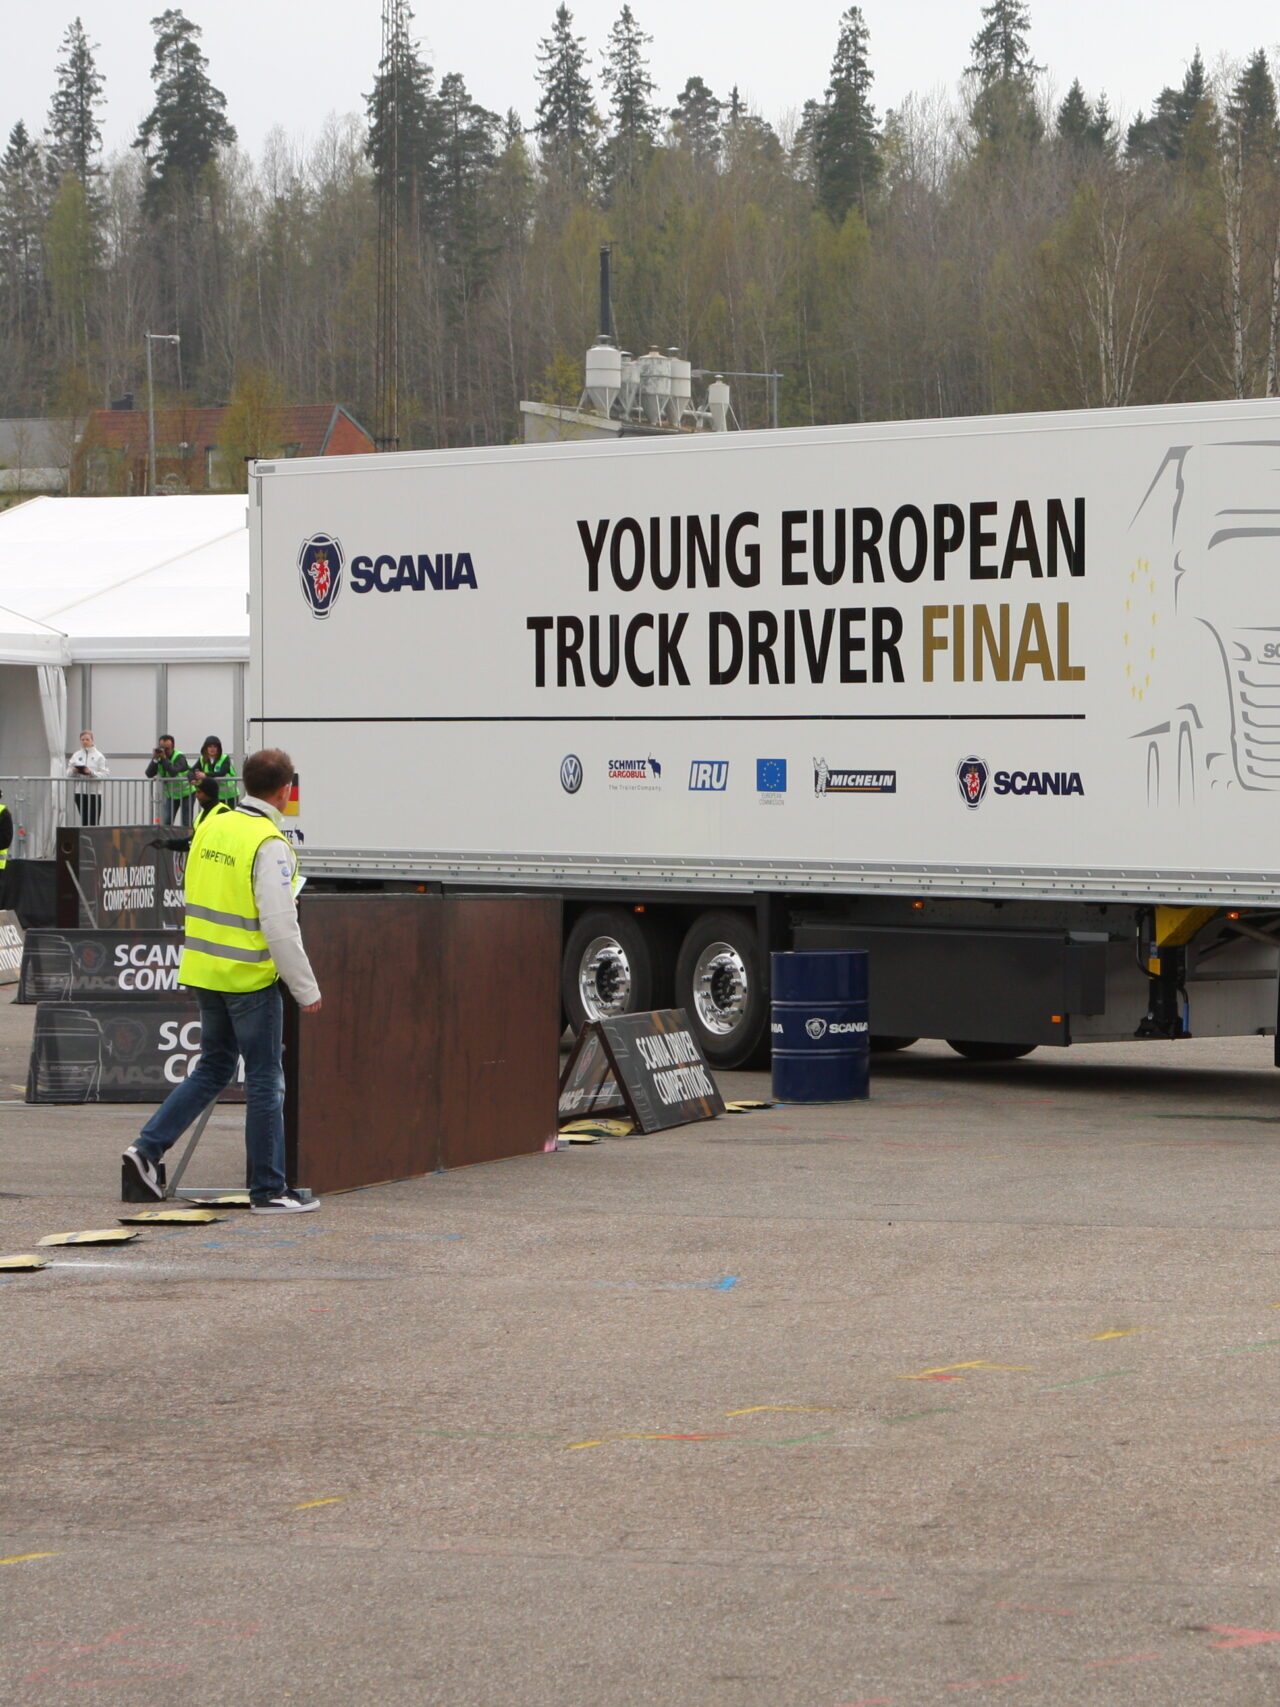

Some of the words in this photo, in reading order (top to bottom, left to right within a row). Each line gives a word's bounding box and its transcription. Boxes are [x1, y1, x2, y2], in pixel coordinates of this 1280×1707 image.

[577, 510, 761, 593] YOUNG
[781, 497, 1086, 586] EUROPEAN
[349, 552, 479, 594] SCANIA
[526, 612, 692, 689] TRUCK
[708, 606, 906, 687] DRIVER
[922, 601, 1086, 683] FINAL
[608, 760, 647, 770] SCHMITZ
[608, 770, 647, 779] CARGOBULL
[690, 763, 728, 790] IRU
[830, 773, 895, 787] MICHELIN
[993, 770, 1085, 796] SCANIA
[103, 867, 129, 889] SCANIA
[129, 865, 156, 887] DRIVER
[103, 887, 155, 911] COMPETITIONS
[828, 1021, 869, 1035] SCANIA
[635, 1034, 677, 1071] SCANIA
[663, 1030, 701, 1065] DRIVER
[652, 1064, 714, 1106] COMPETITIONS
